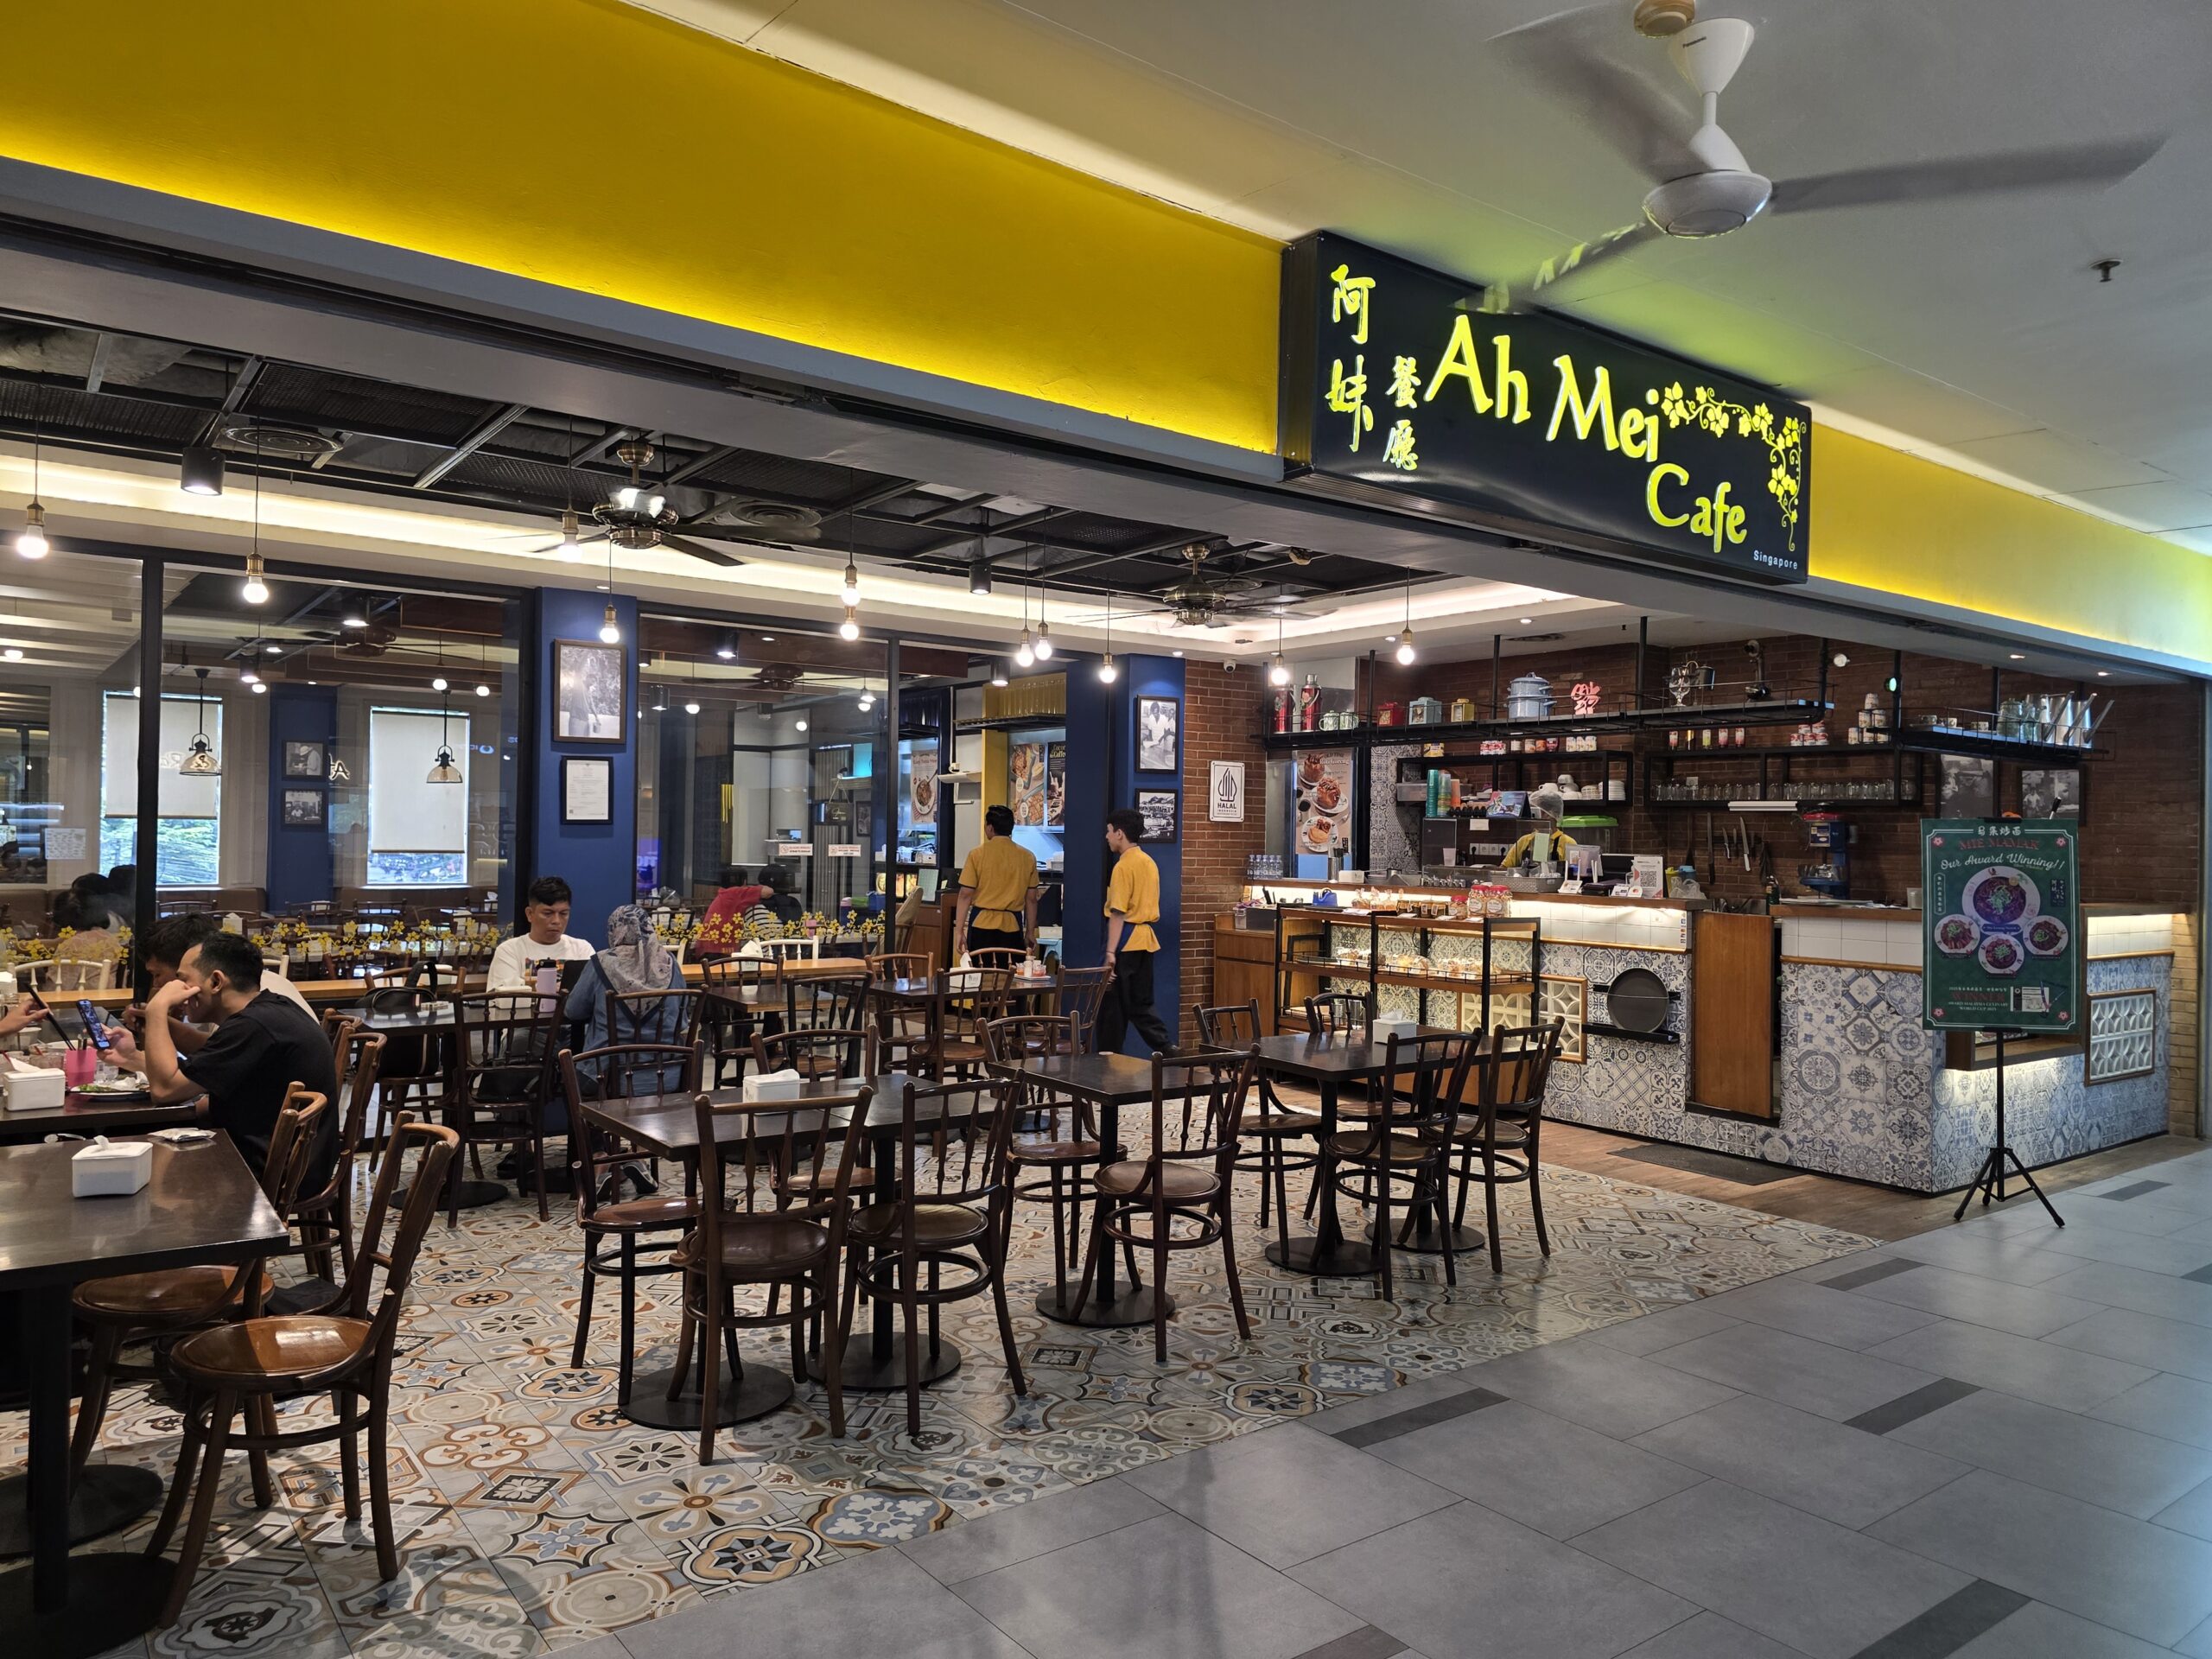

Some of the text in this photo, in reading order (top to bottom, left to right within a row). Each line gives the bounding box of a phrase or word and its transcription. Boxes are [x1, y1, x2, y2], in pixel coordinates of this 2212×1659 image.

[1325, 264, 1376, 453] 阿妹
[1422, 314, 1660, 463] Ah Mei
[1645, 462, 1748, 554] Cafe
[1753, 550, 1798, 570] Singapore
[1941, 859, 1962, 870] Our
[1964, 853, 2005, 866] Award
[2006, 853, 2066, 871] Winning!!
